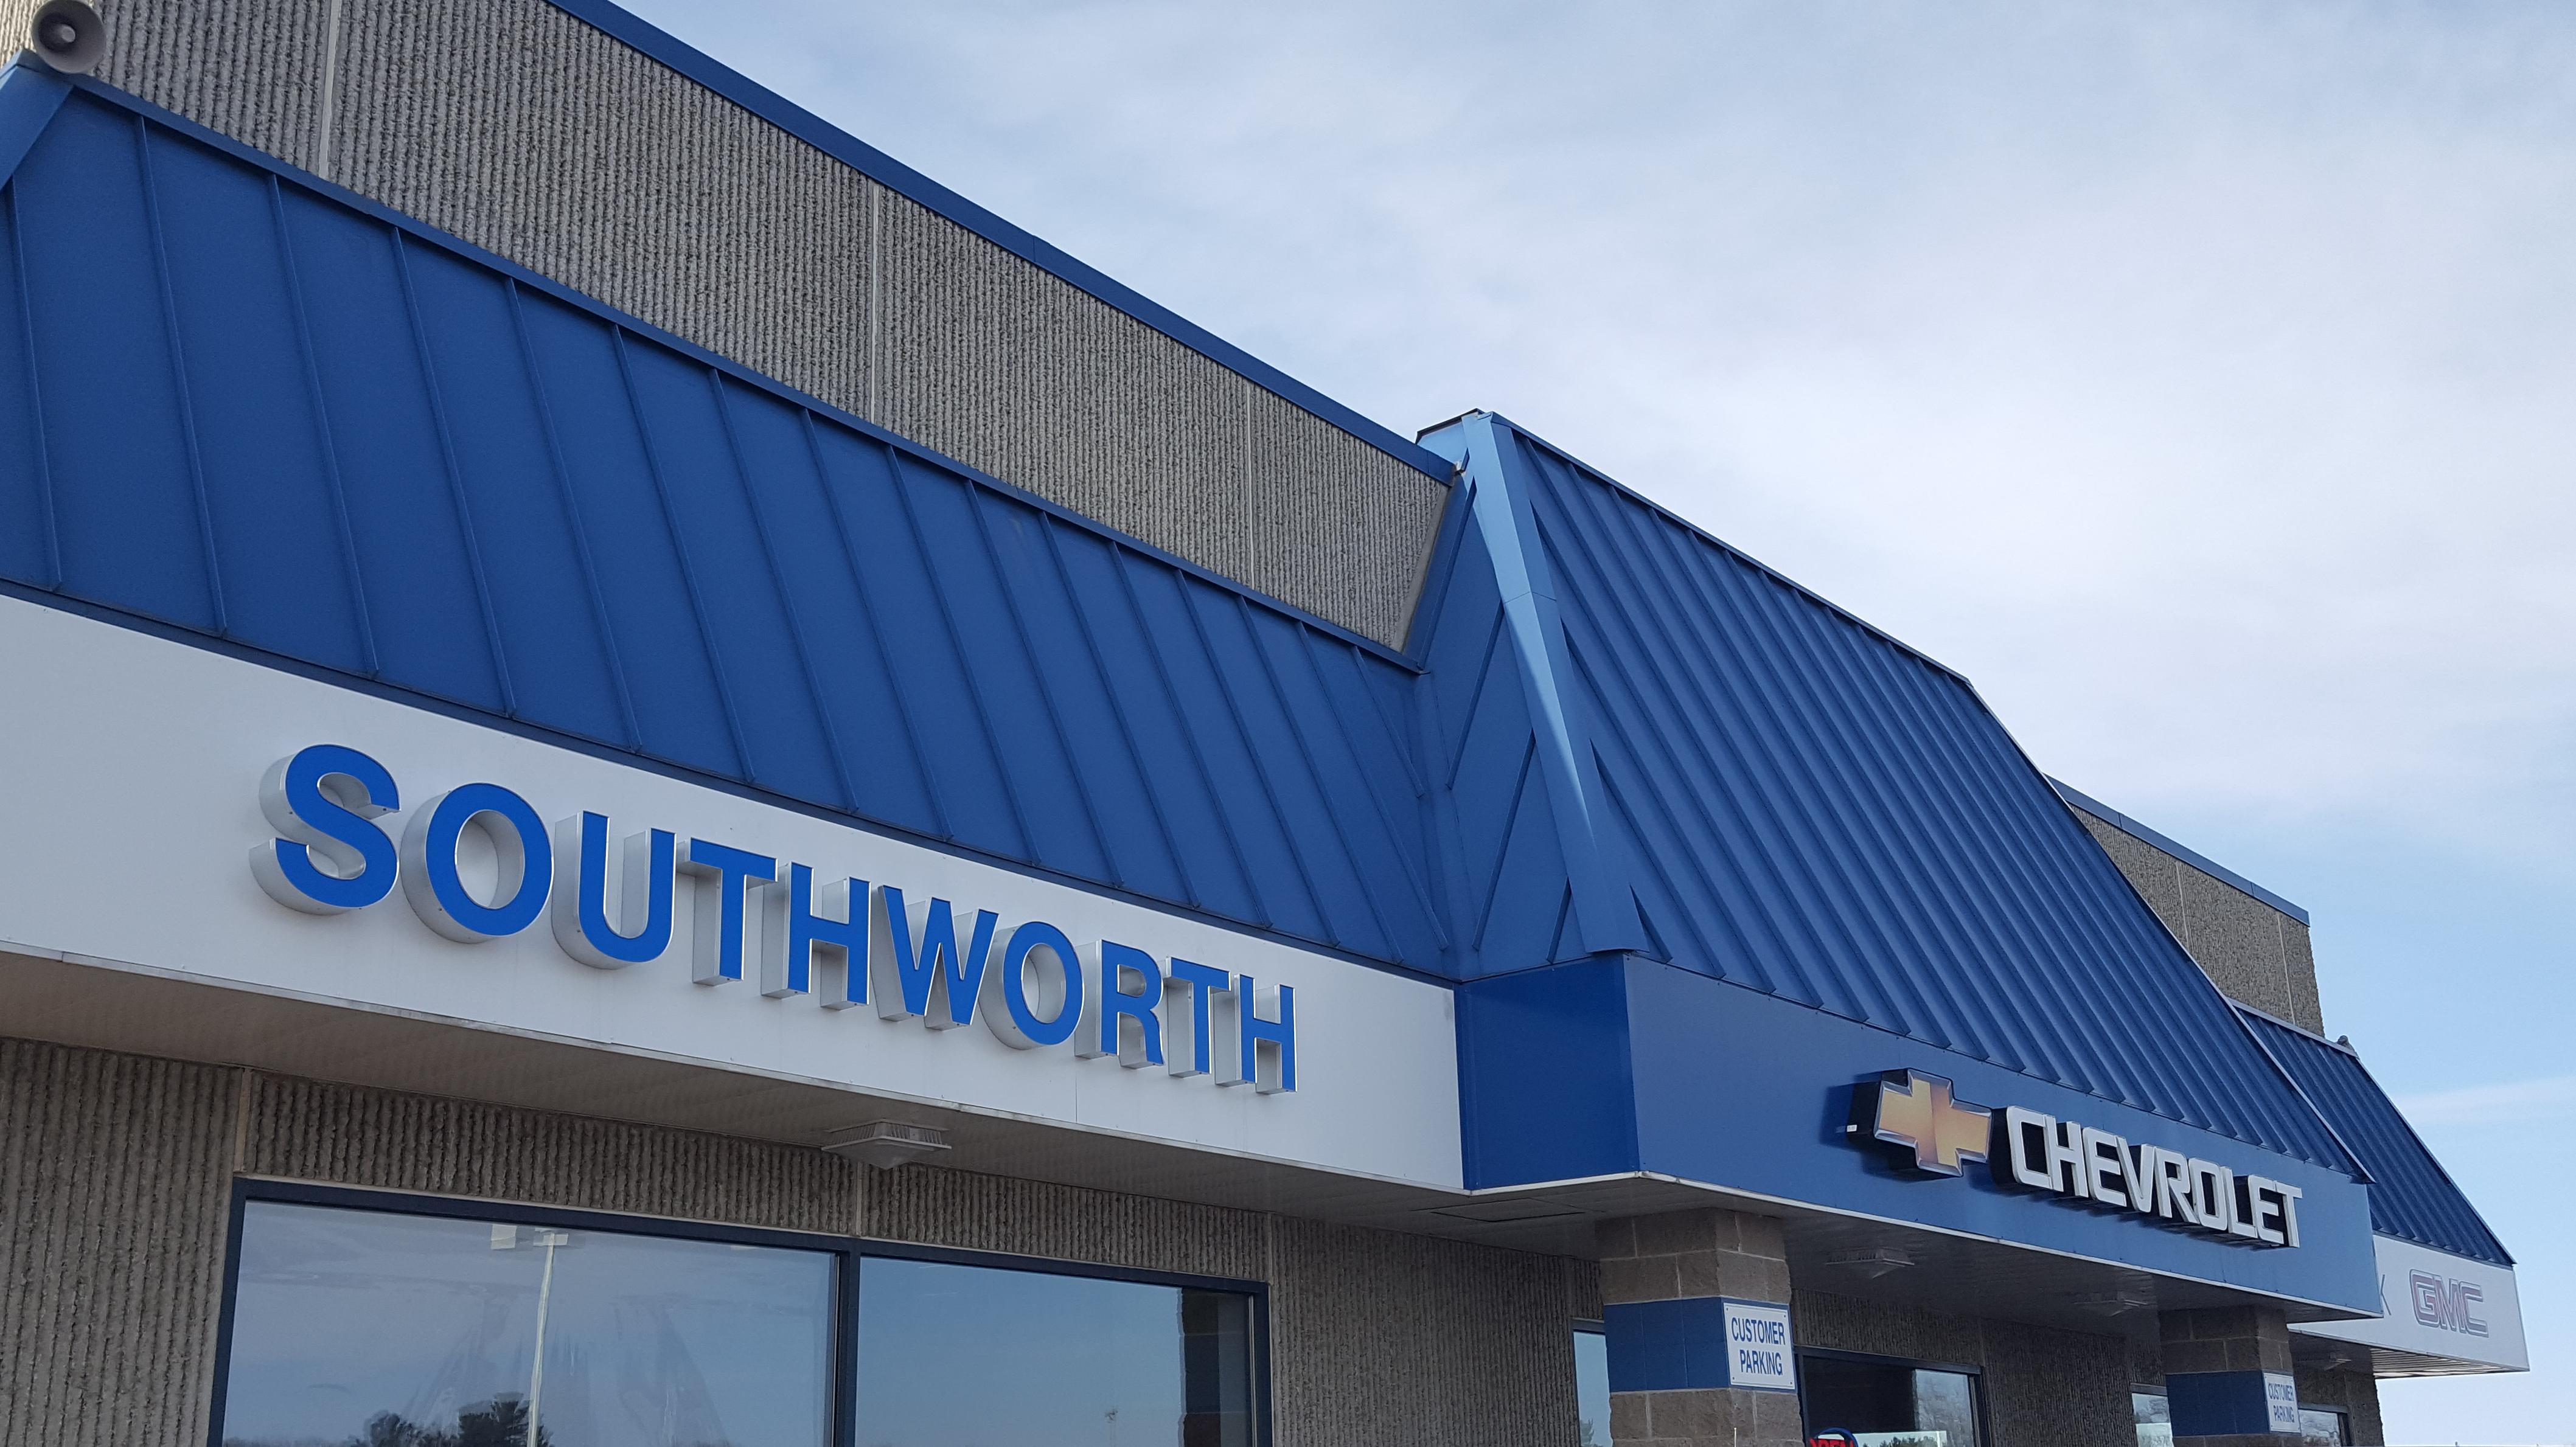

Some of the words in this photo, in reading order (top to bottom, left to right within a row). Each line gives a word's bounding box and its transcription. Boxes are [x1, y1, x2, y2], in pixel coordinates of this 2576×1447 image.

[273, 744, 1295, 1093] SOUTHWORTH
[2007, 1105, 2303, 1247] CHEVROLET
[2409, 1269, 2489, 1338] GMC
[1732, 1317, 1786, 1345] CUSTOMER
[1739, 1349, 1783, 1376] PARKING
[2268, 1382, 2294, 1402] CUSTOMER
[2273, 1405, 2296, 1423] PARKING
